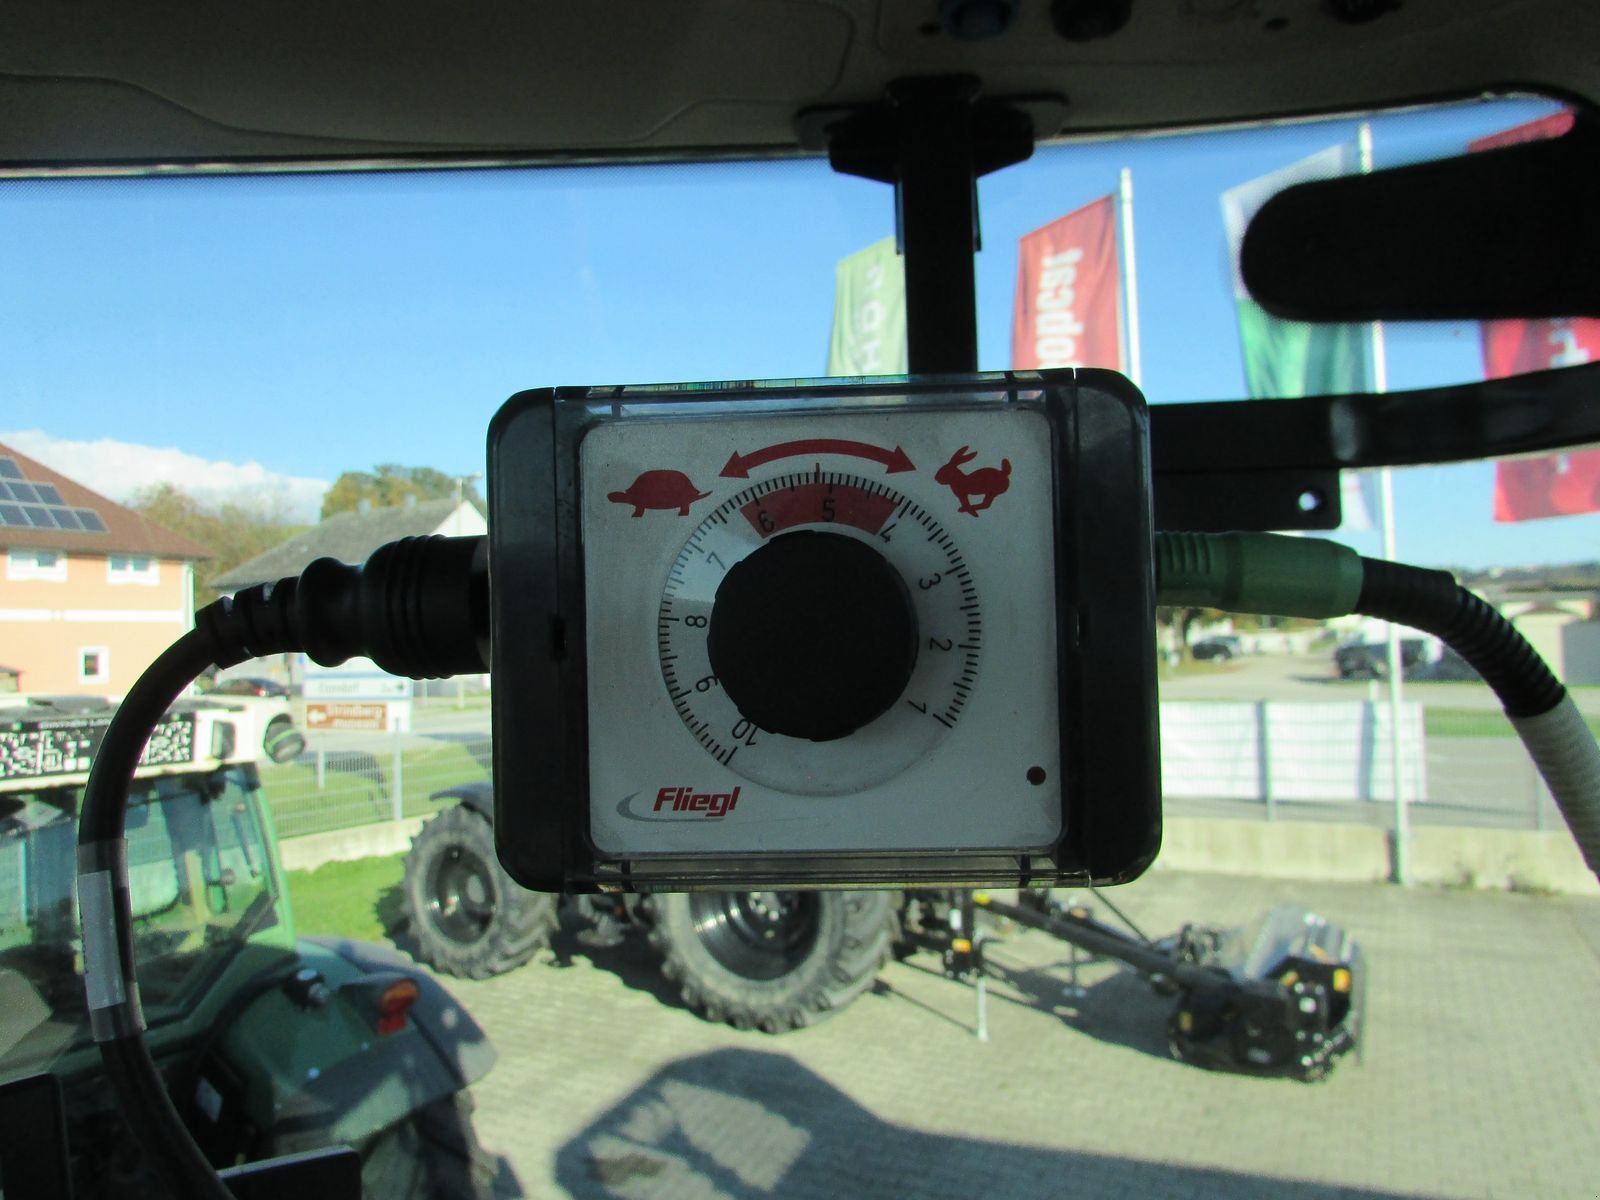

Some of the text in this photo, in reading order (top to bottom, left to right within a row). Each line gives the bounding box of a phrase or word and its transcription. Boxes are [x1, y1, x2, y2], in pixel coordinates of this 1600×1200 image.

[821, 497, 836, 522] 5
[757, 509, 775, 532] 6
[879, 522, 897, 543] 4
[705, 551, 727, 571] 7
[918, 572, 942, 591] 3
[684, 615, 708, 629] 8
[929, 636, 953, 652] 2
[695, 675, 719, 693] 9
[907, 699, 927, 715] 1
[731, 718, 758, 746] 10
[653, 786, 742, 818] Fliegl
